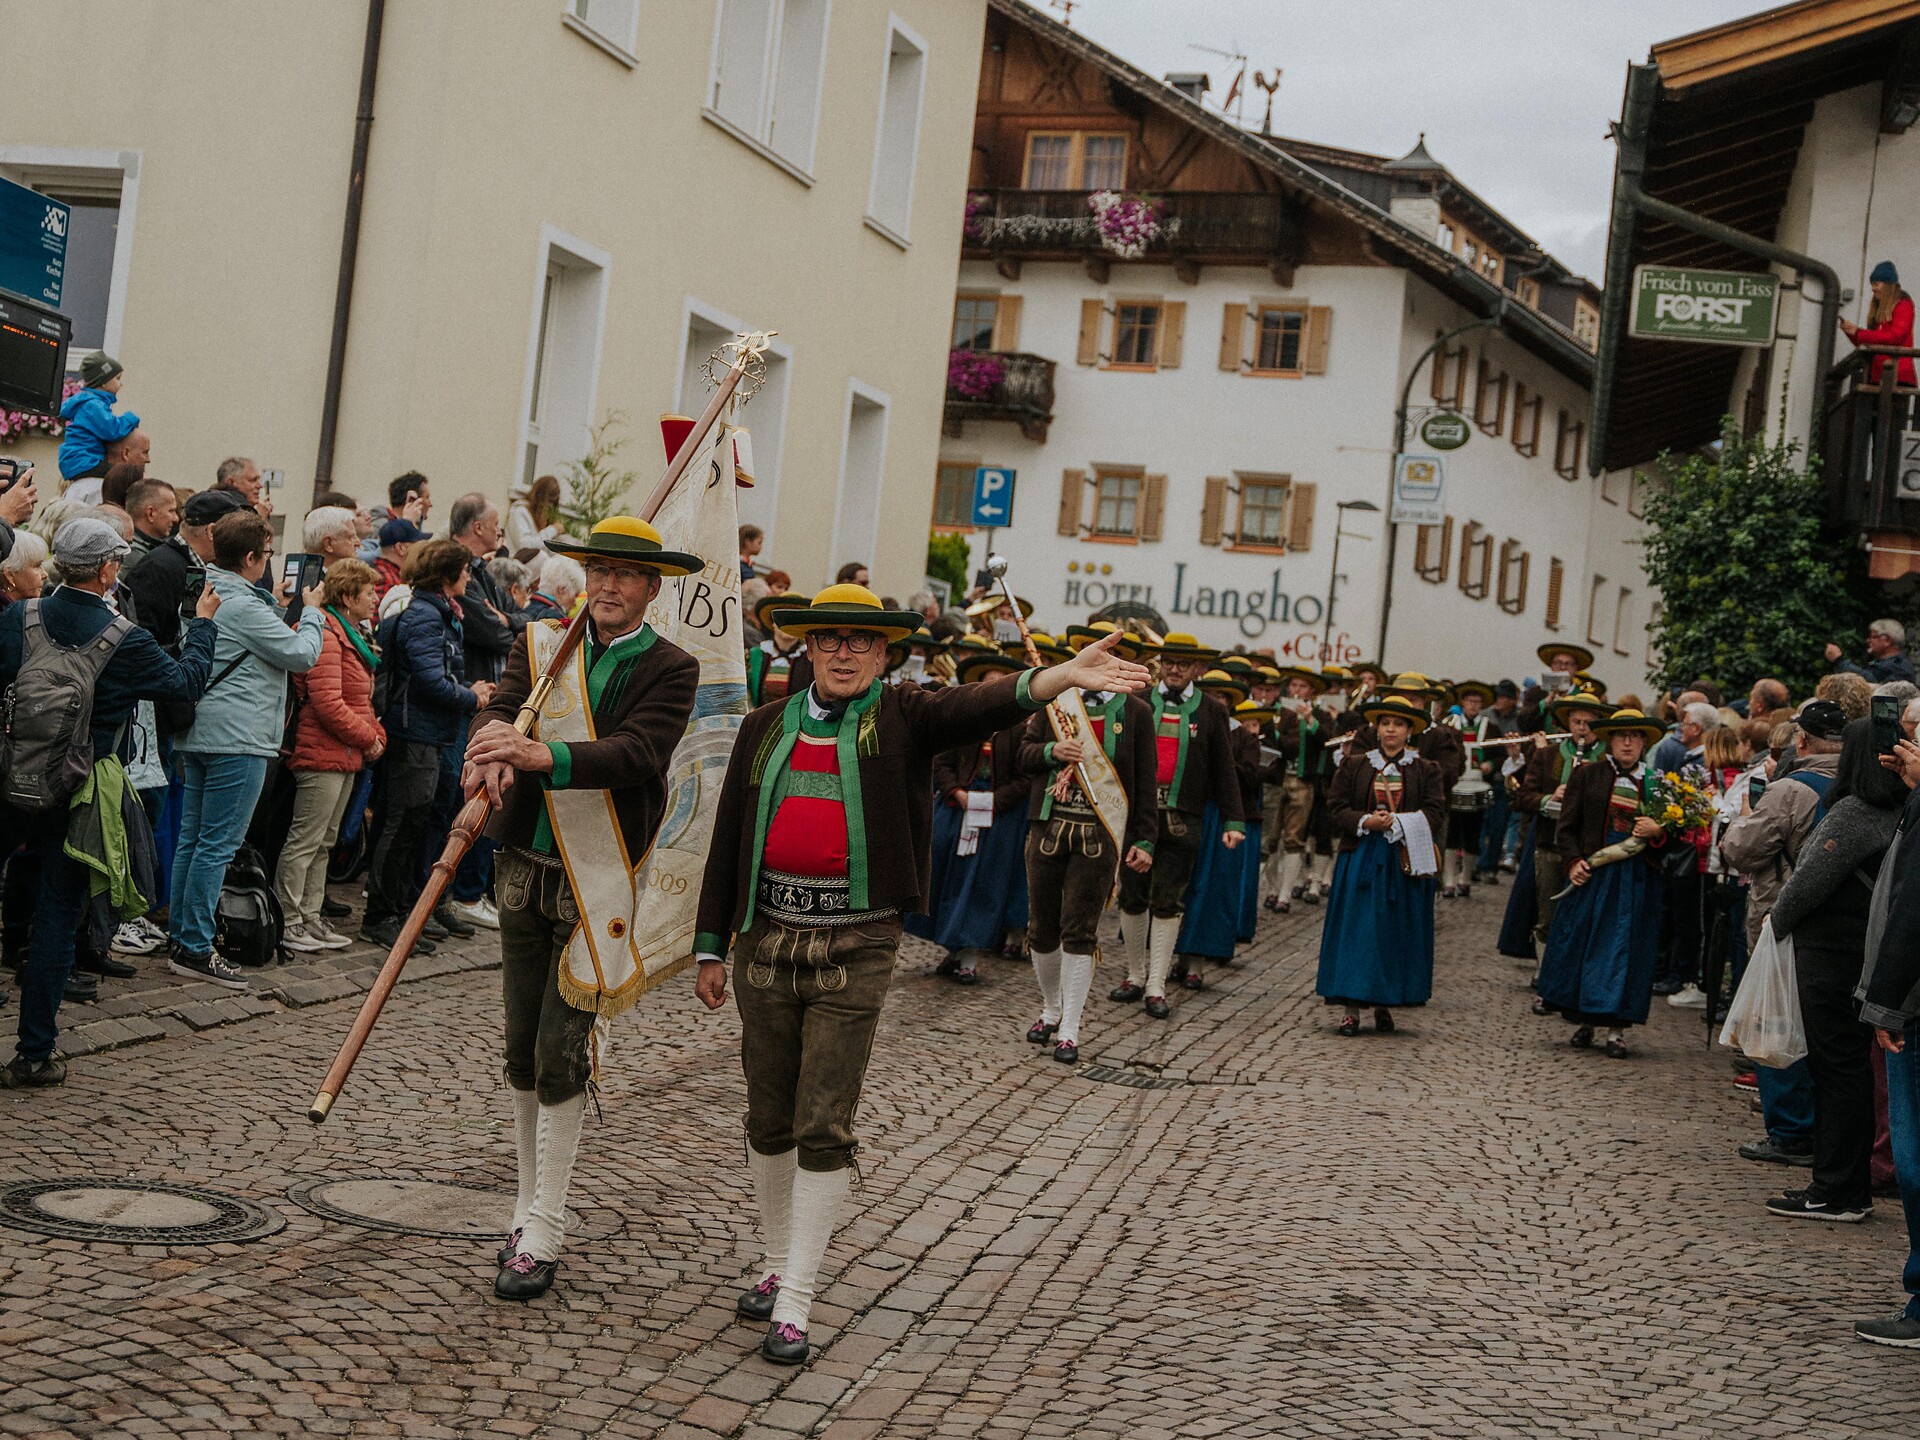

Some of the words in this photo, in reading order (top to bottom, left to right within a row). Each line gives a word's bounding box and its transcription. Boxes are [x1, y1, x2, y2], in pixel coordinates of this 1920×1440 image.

[1641, 271, 1691, 292] Frisch
[1696, 280, 1733, 295] vom
[1737, 277, 1772, 297] Fass
[1655, 293, 1752, 324] FORST
[1905, 437, 1920, 460] Z
[982, 470, 1005, 499] P
[1170, 563, 1348, 638] Langhof
[1294, 632, 1361, 664] Cafe
